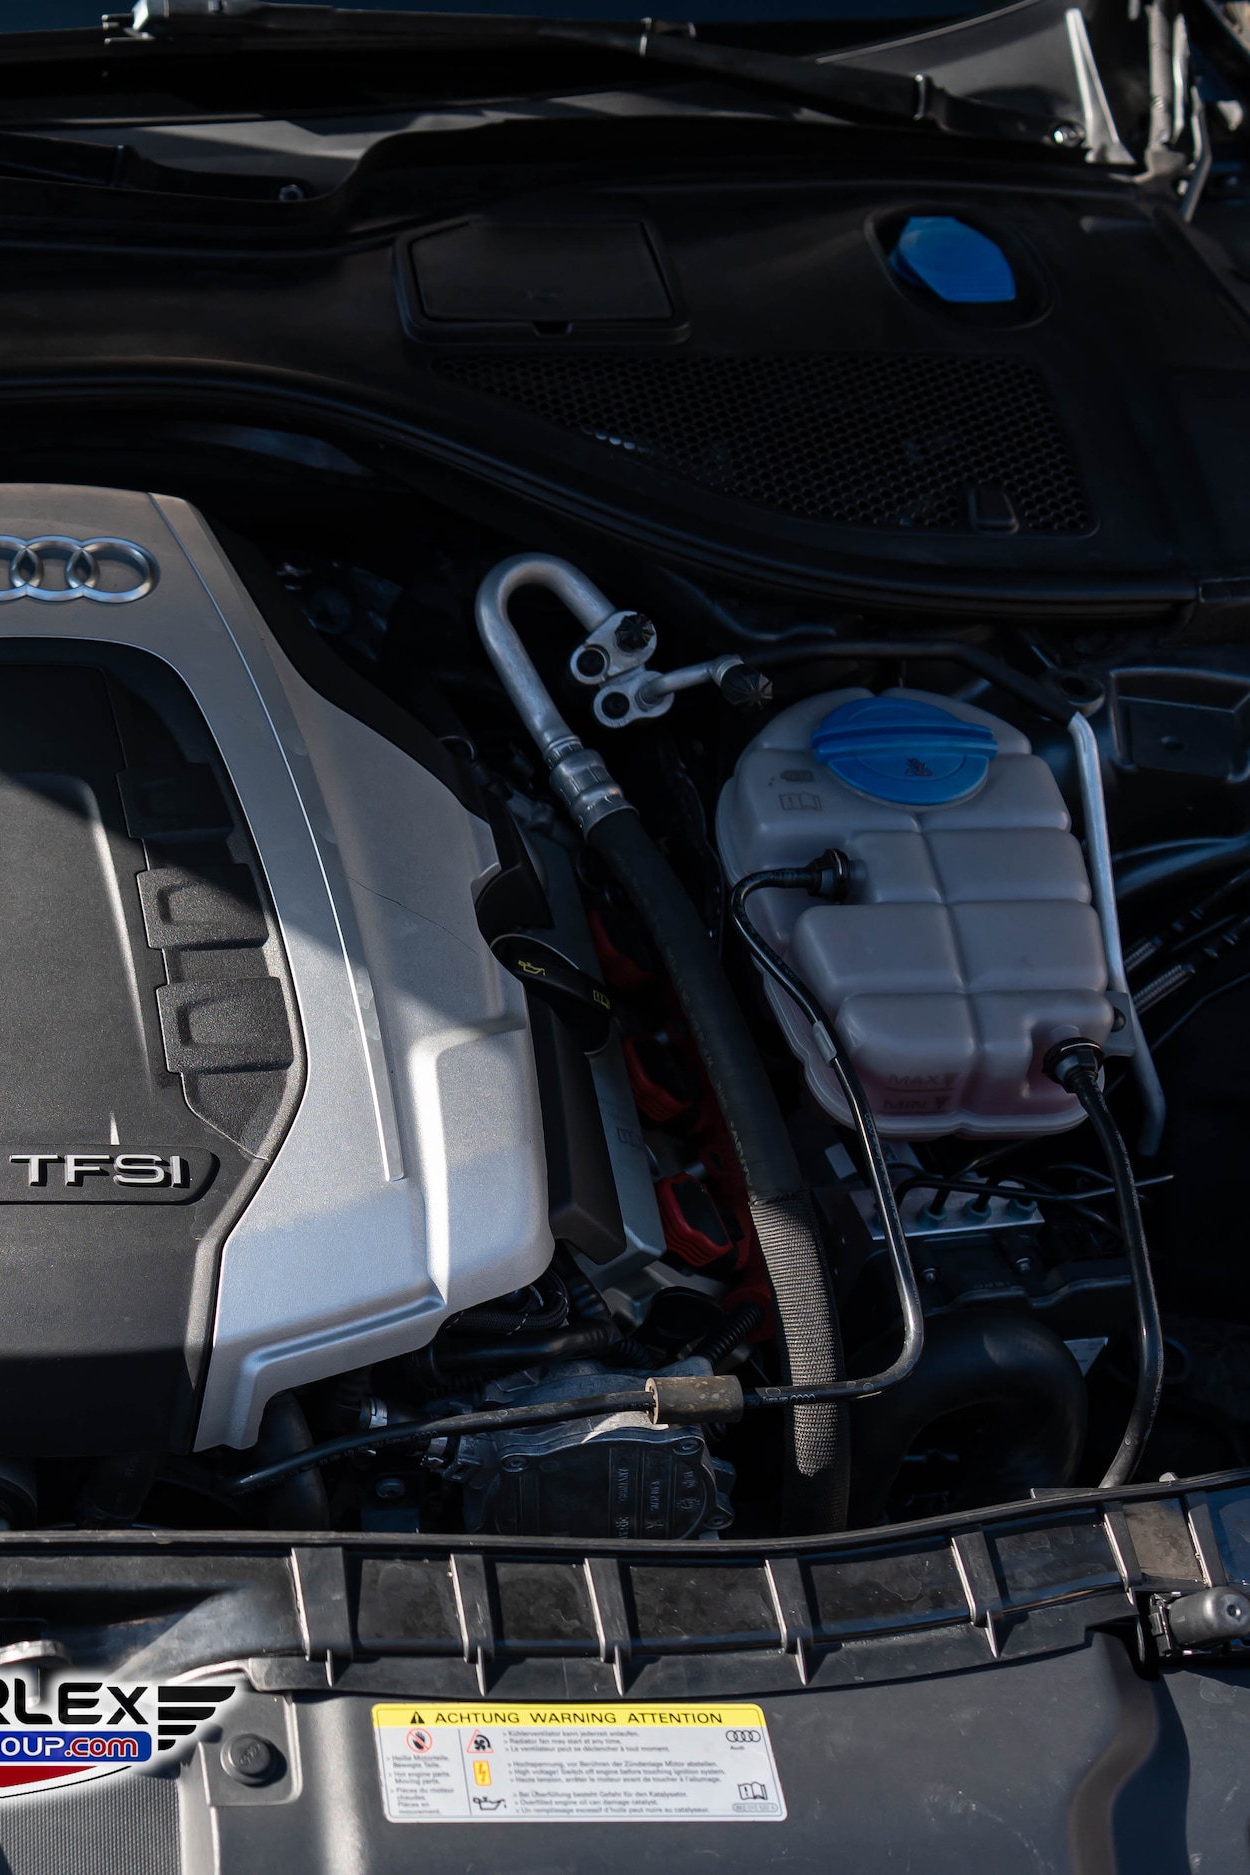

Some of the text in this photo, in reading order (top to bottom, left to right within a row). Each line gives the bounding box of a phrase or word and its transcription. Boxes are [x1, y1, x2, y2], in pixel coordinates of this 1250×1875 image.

[888, 1073, 939, 1086] MAX
[883, 1099, 927, 1110] MIN
[11, 1154, 192, 1189] TFSI
[435, 1712, 723, 1724] ACHTUNG WARNING ATTENTION
